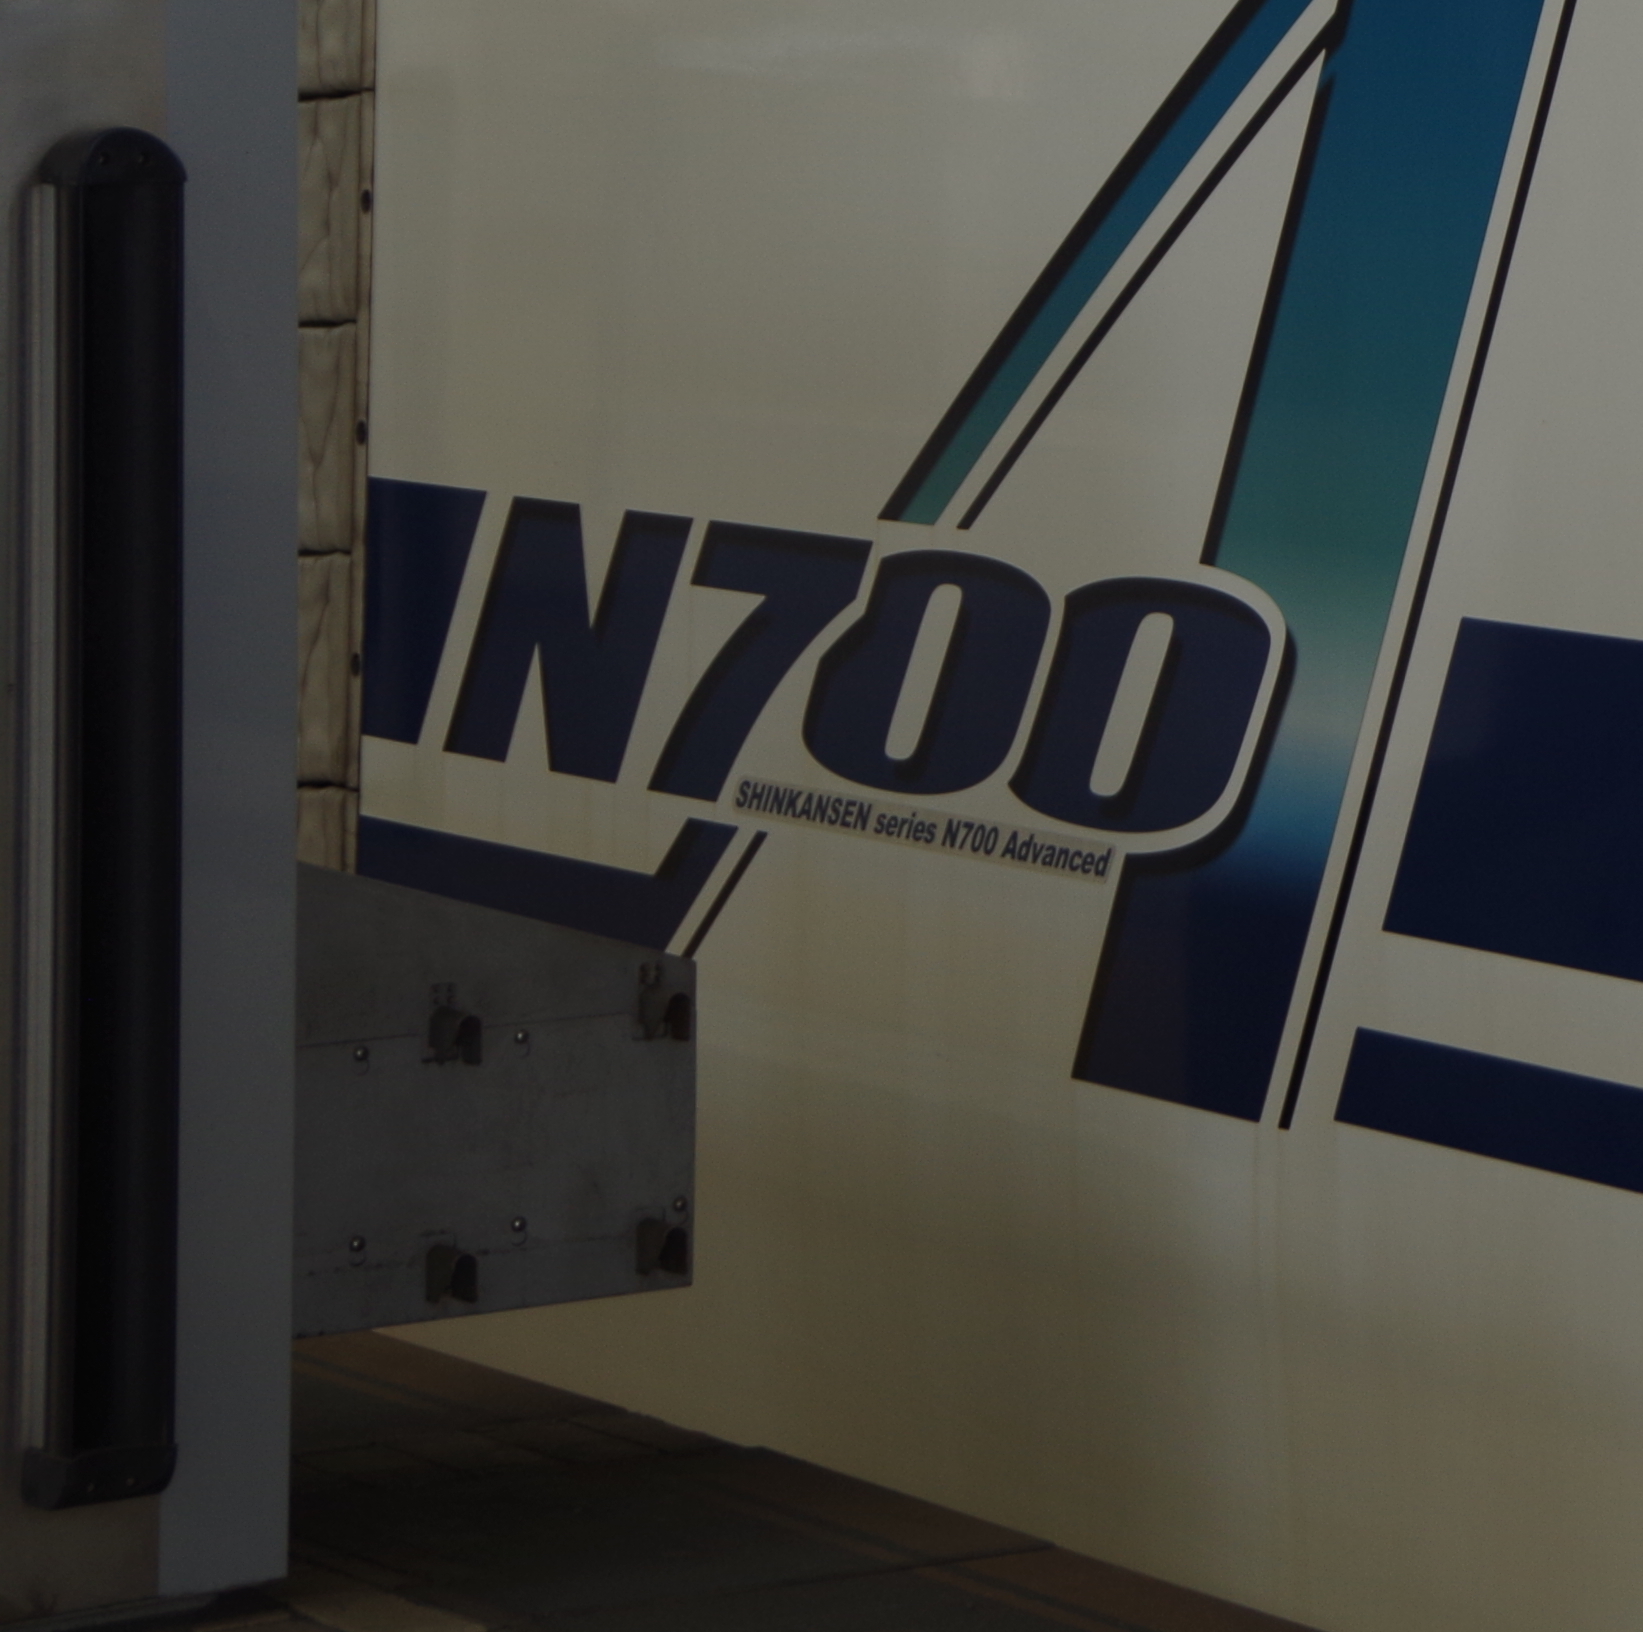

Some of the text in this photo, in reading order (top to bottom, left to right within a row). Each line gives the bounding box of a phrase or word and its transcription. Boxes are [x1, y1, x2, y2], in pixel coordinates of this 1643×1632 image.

[443, 495, 1272, 833] N700
[735, 779, 1113, 878] SHINKANSEN series N700 Advanced
